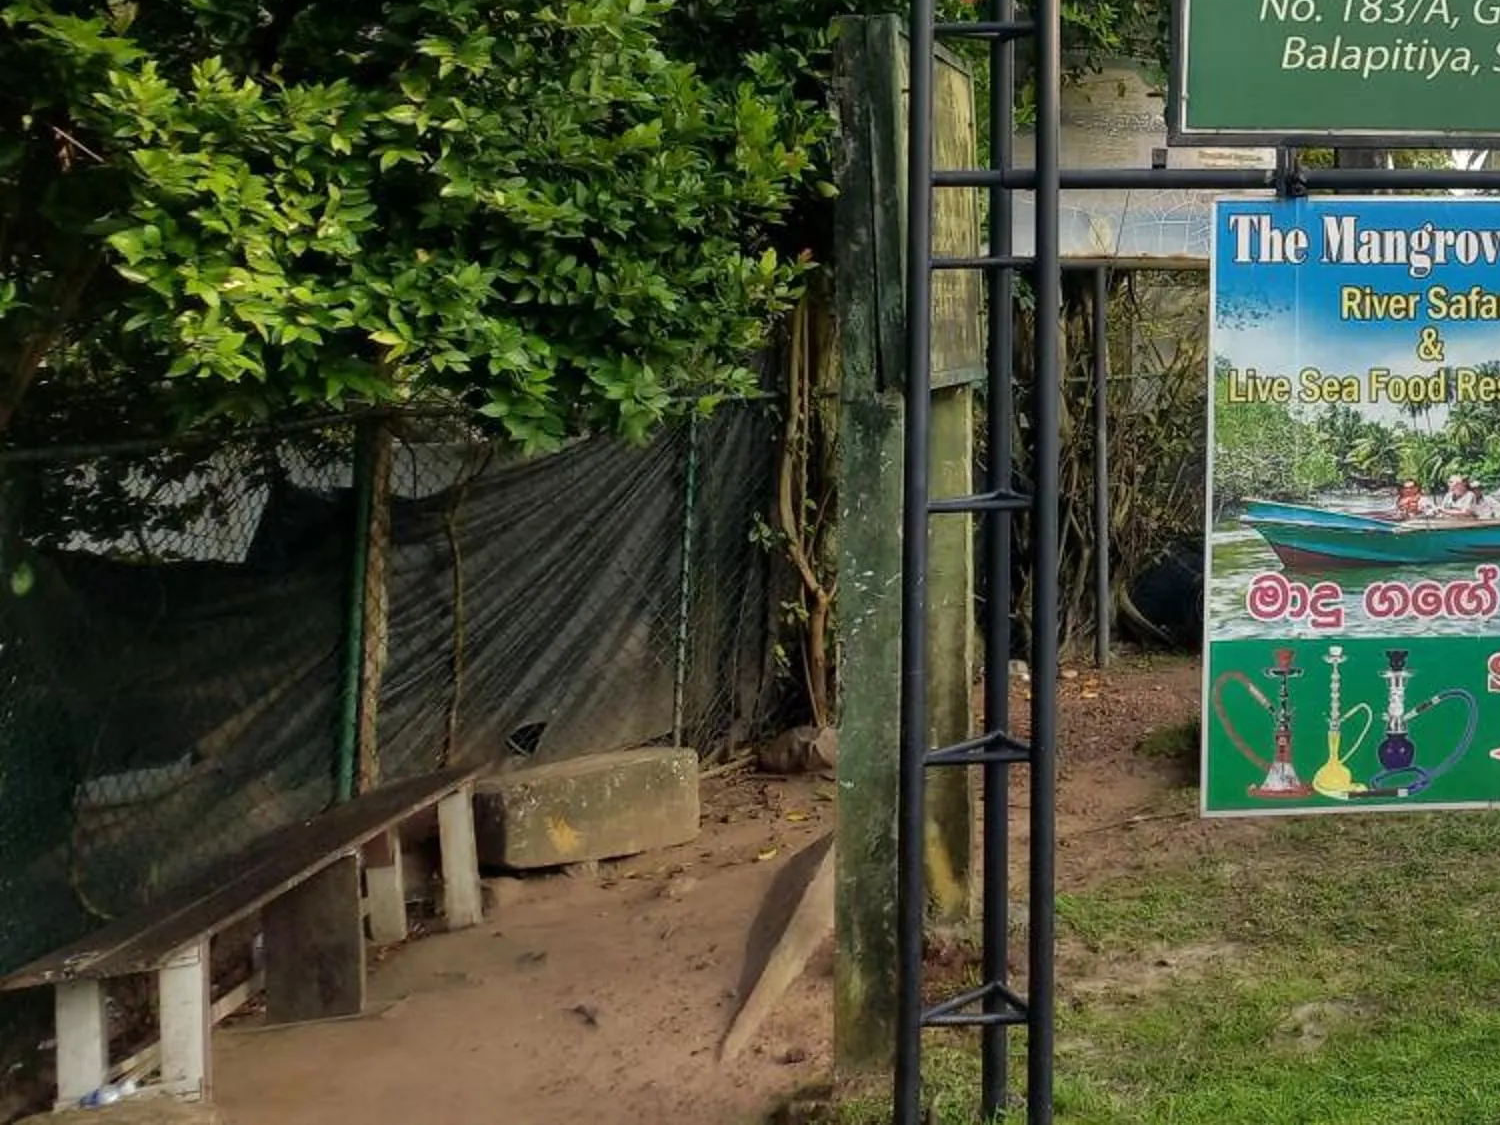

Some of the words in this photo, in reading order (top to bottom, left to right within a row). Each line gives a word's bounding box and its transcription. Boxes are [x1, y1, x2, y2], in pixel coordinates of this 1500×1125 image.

[1281, 37, 1480, 79] Balapitiya,
[1229, 214, 1308, 264] The
[1340, 286, 1420, 320] River
[1417, 327, 1445, 361] &
[1228, 370, 1291, 404] Live
[1298, 370, 1360, 403] Sea
[1369, 369, 1447, 403] Food
